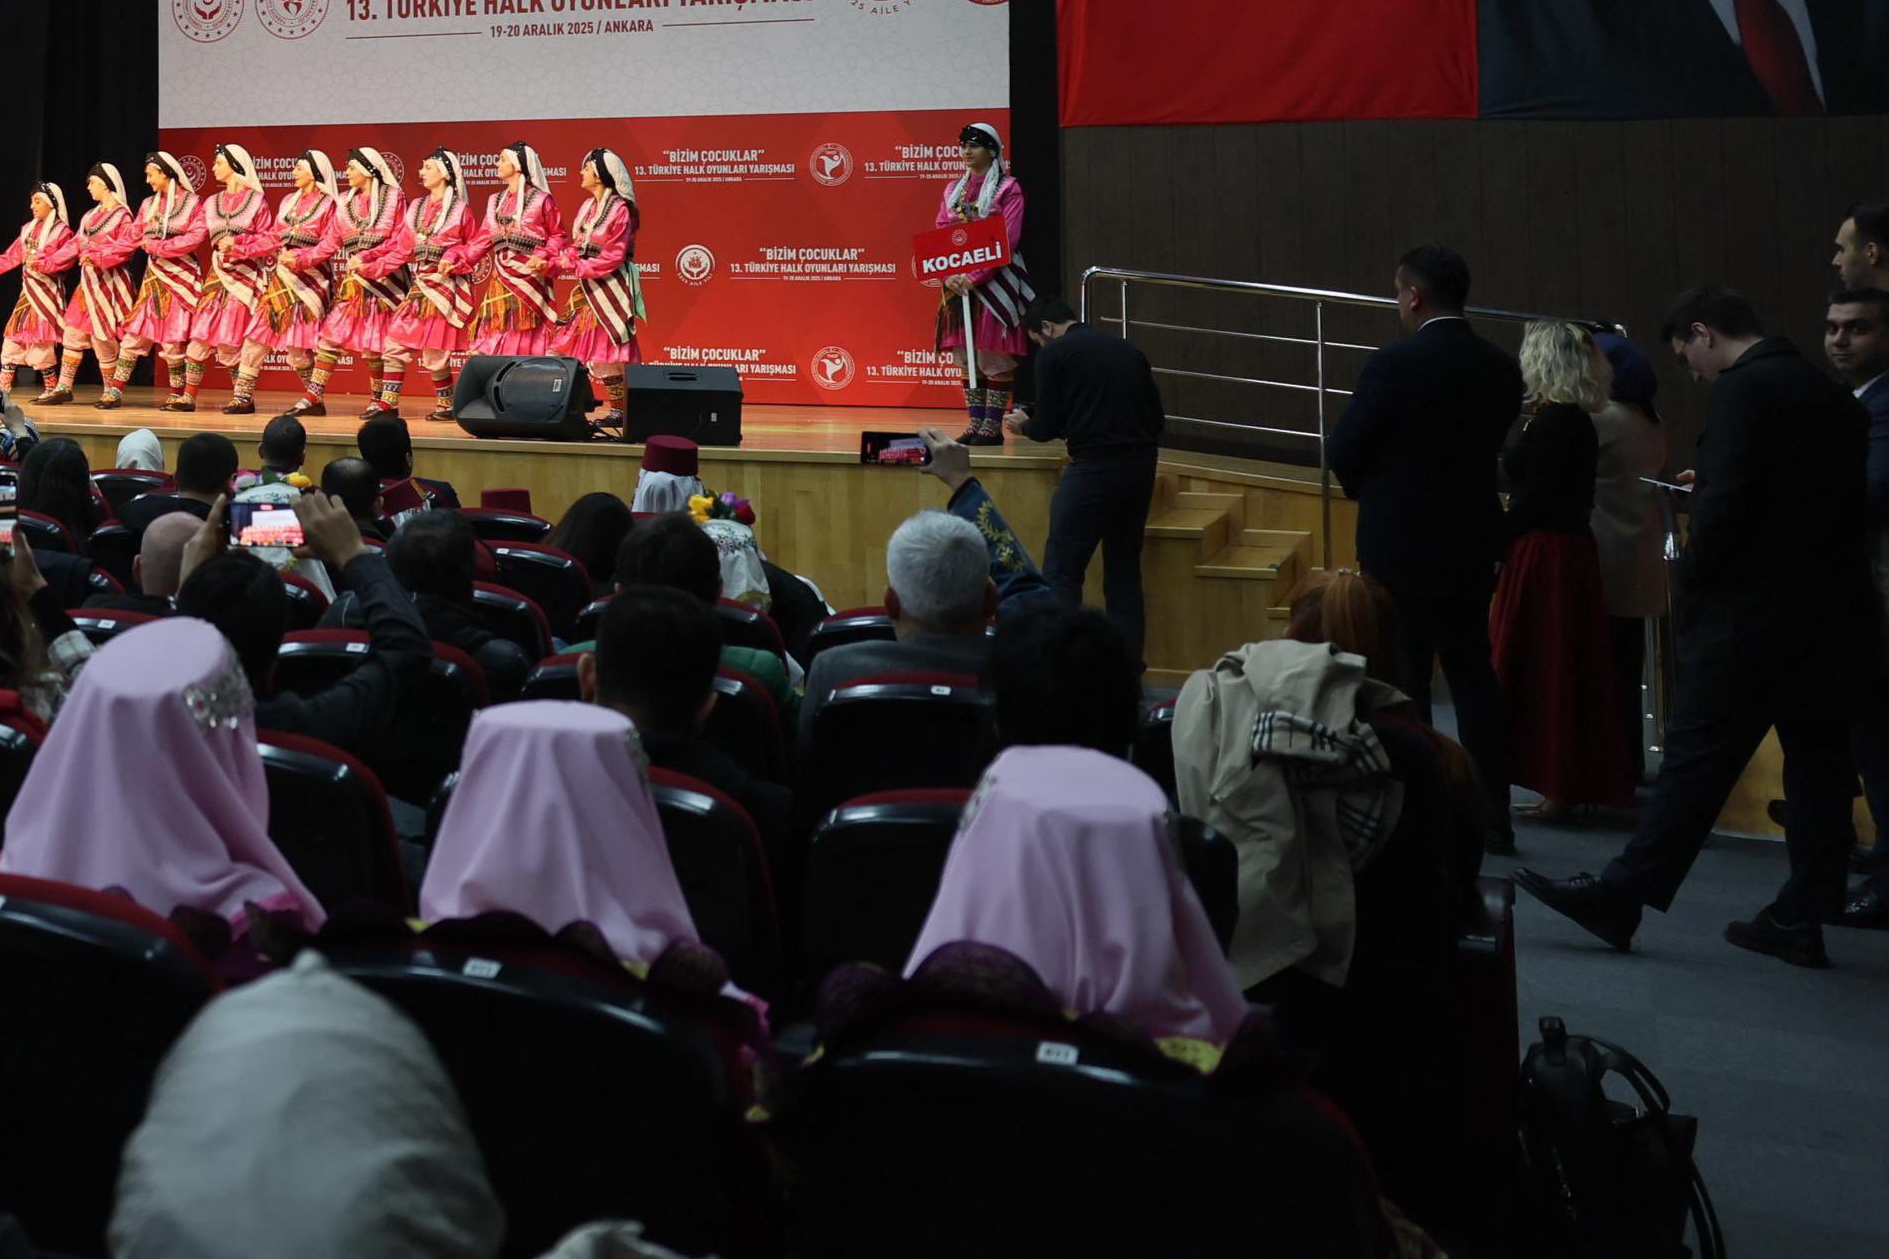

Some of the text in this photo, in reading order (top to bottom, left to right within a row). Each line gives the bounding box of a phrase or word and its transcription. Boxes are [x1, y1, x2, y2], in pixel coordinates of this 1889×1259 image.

[490, 19, 654, 38] 19-20 ARALIK 2025 / ANKARA
[635, 163, 795, 176] 13. TÜRKİYE HALK OYUNLARI YARIŞMASI
[864, 162, 877, 172] 13.
[879, 160, 915, 172] TÜRKİYE
[916, 161, 940, 171] HALK
[922, 241, 1002, 274] KOCAELİ
[730, 261, 896, 276] 13. TÜRKİYE HALK OYUNLARI YARIŞMASI
[750, 364, 797, 376] YARIŞMASI
[866, 366, 880, 376] 13.
[881, 364, 918, 377] TÜRKİYE
[919, 366, 943, 377] HALK
